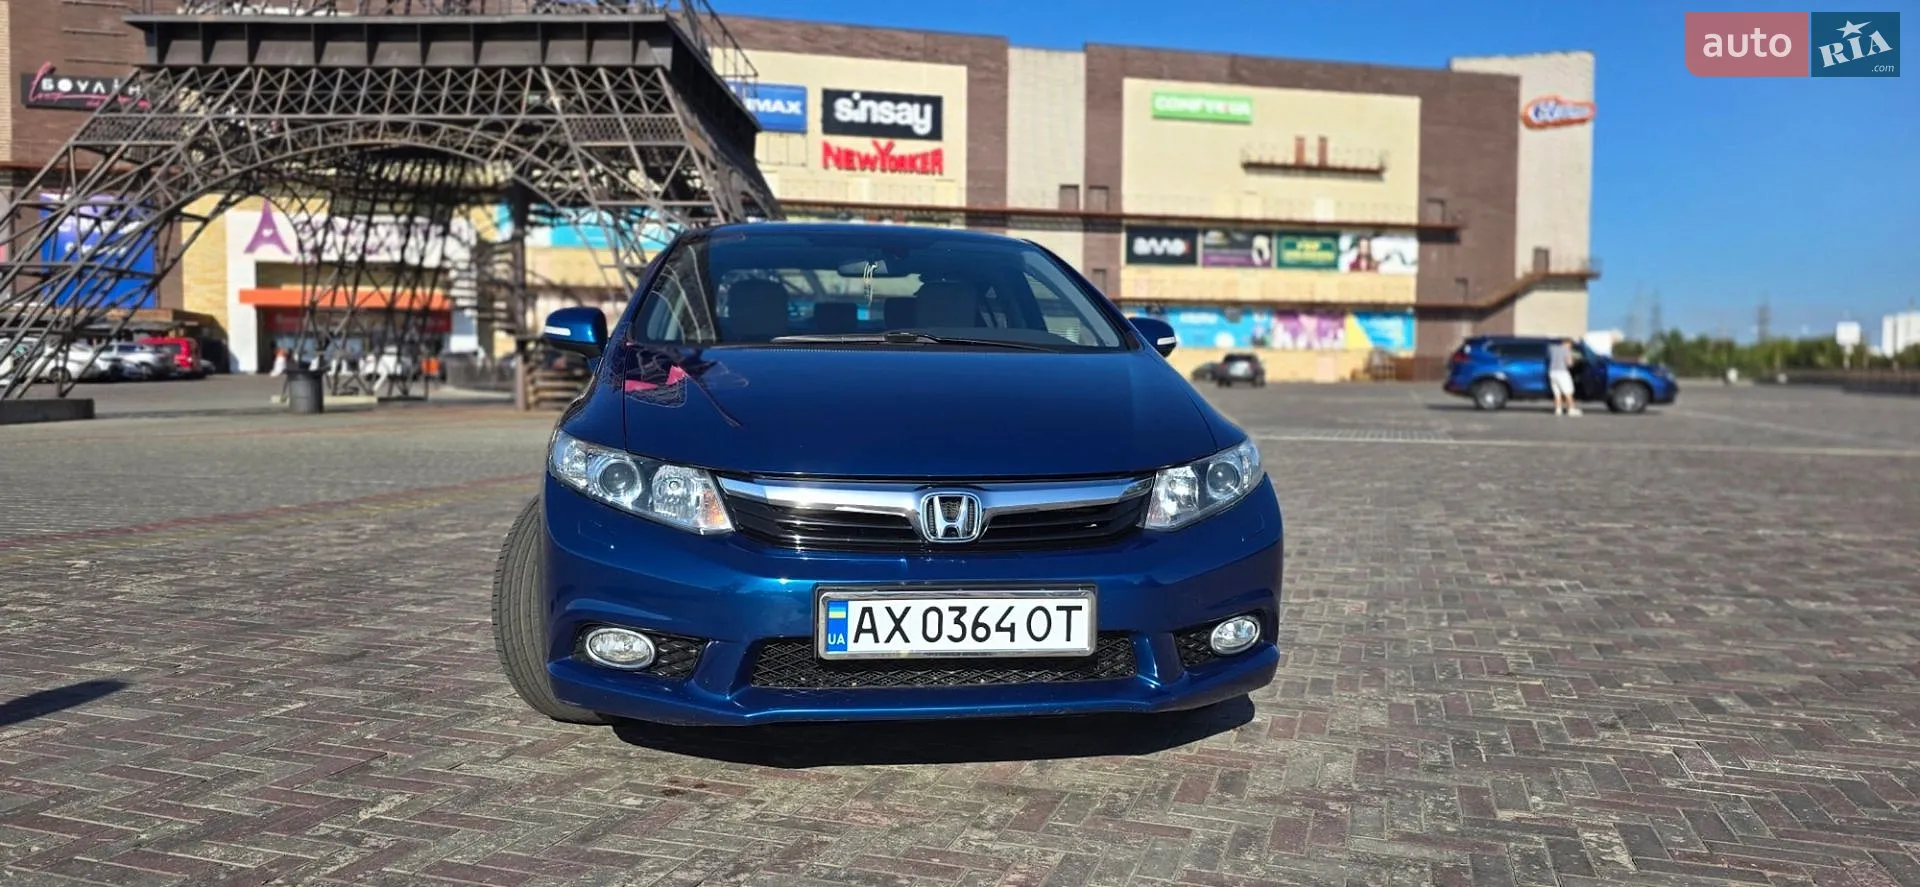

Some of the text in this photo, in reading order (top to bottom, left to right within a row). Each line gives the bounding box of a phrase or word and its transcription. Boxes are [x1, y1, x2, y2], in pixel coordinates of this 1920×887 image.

[834, 92, 933, 135] sinsay
[828, 633, 846, 645] UA
[853, 605, 1083, 644] AX 0364 OT
